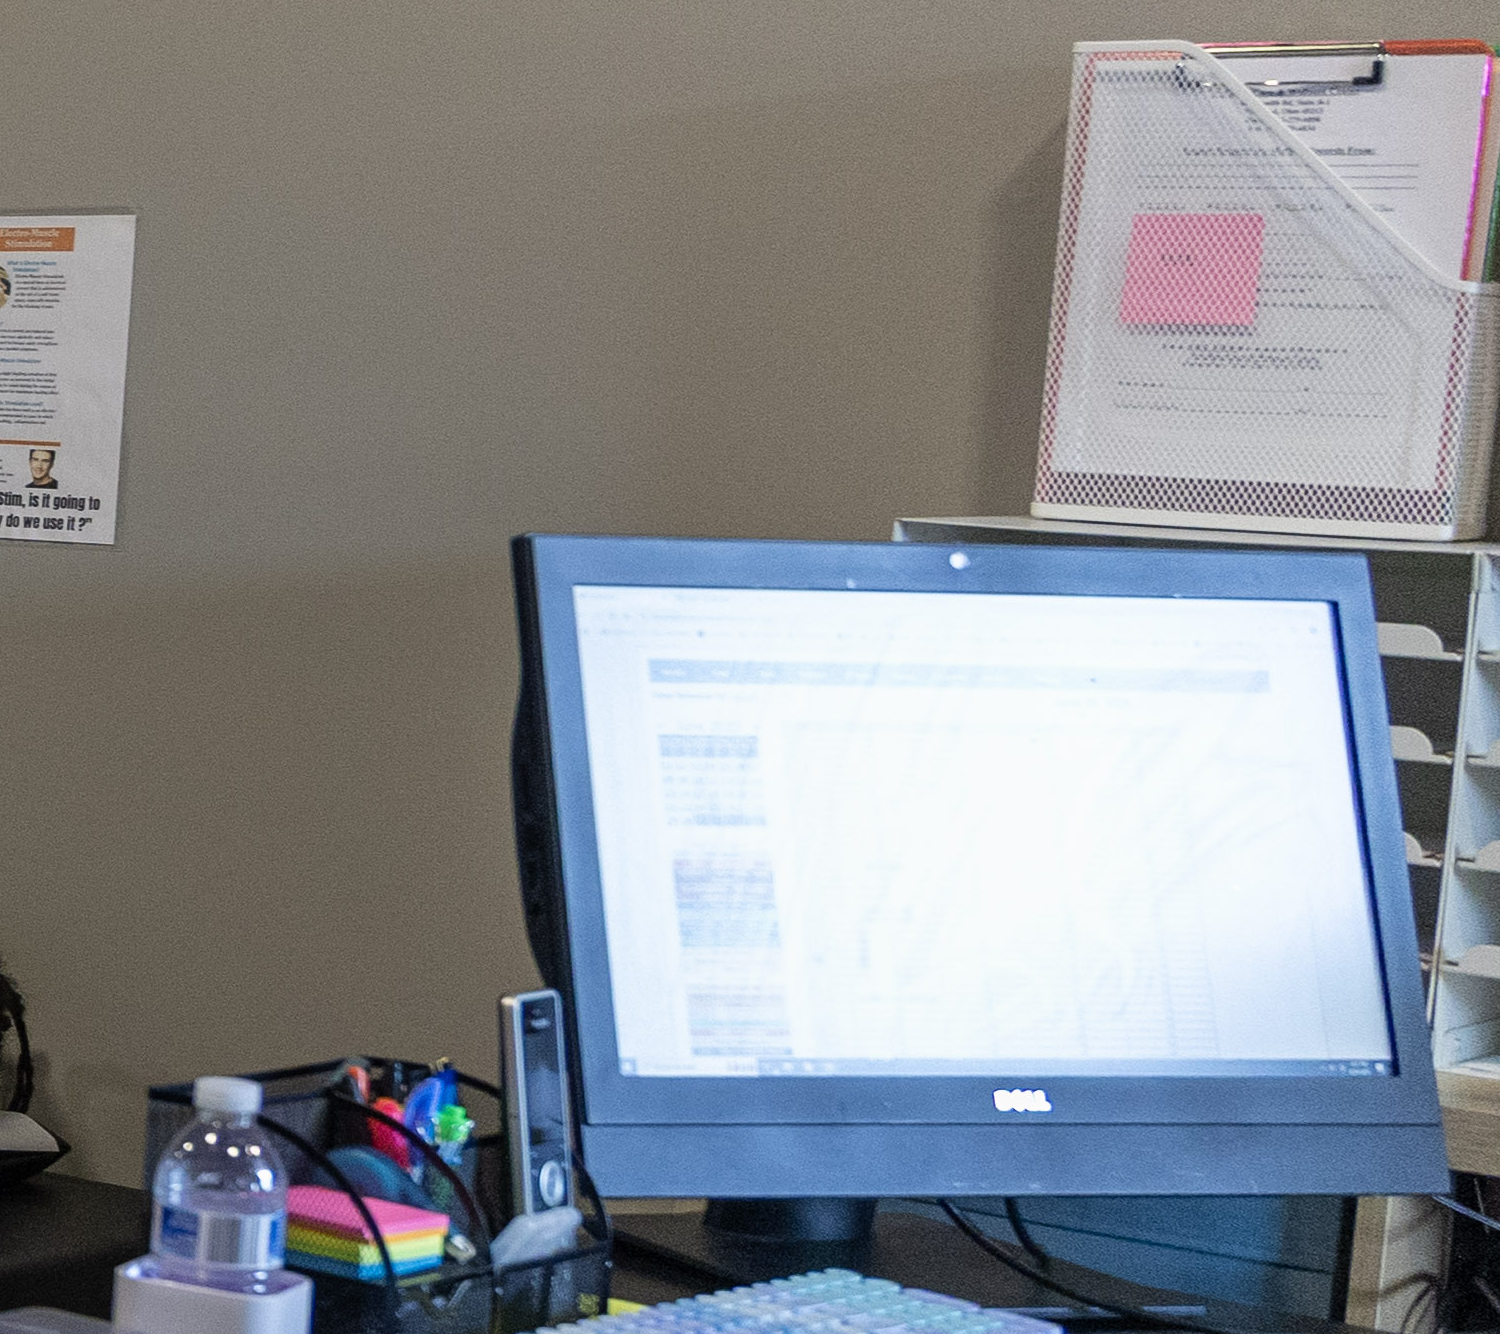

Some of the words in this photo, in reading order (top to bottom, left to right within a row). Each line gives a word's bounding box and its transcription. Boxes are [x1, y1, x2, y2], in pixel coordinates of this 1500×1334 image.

[29, 493, 39, 508] is
[42, 493, 51, 508] it
[53, 495, 85, 511] going
[88, 496, 100, 510] to
[6, 514, 20, 528] do
[23, 516, 39, 529] we
[43, 517, 64, 531] use
[67, 517, 75, 531] it
